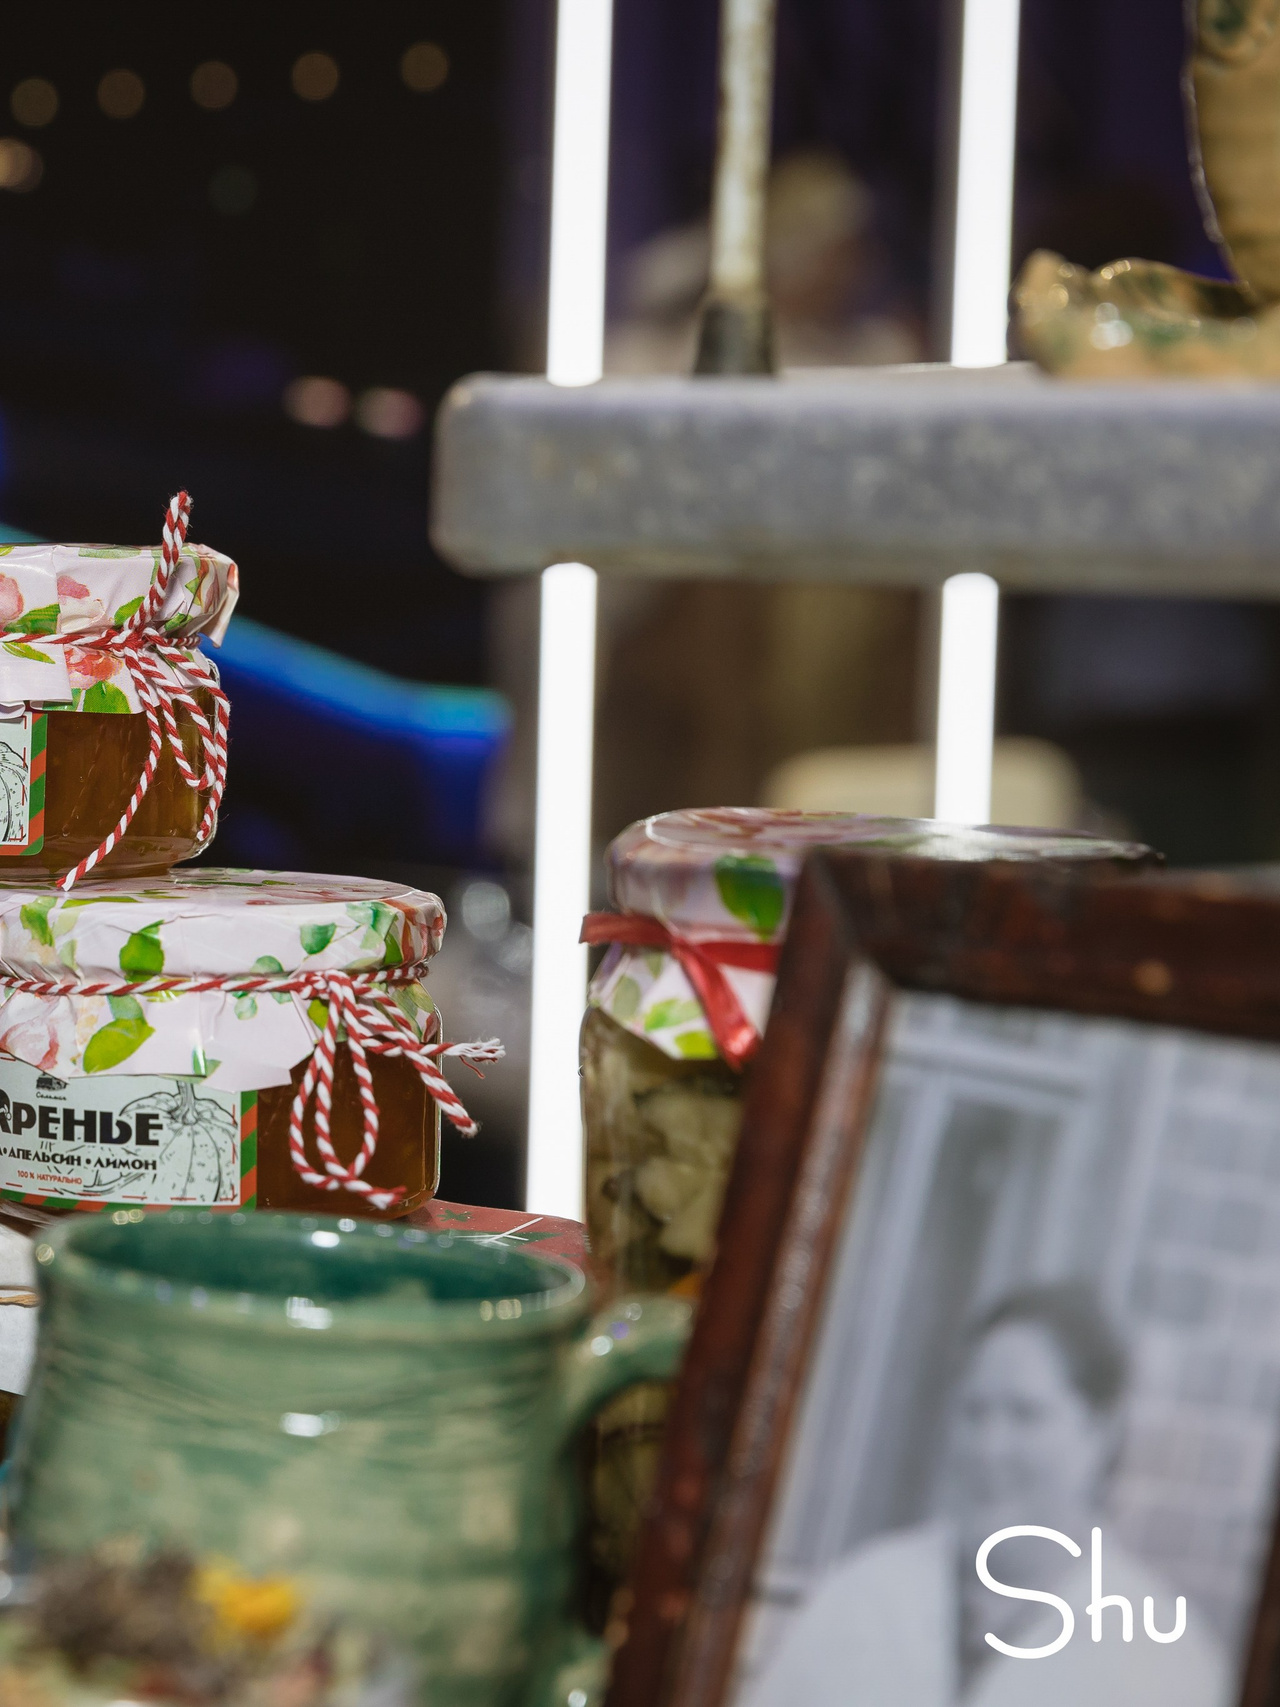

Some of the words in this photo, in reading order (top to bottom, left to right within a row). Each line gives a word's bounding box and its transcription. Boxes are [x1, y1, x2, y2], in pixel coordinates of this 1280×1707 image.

[8, 1147, 81, 1166] АПЕЛЬСИН
[94, 1157, 157, 1171] ЛИМОН
[37, 1173, 82, 1185] НАТУРАЛЬНО
